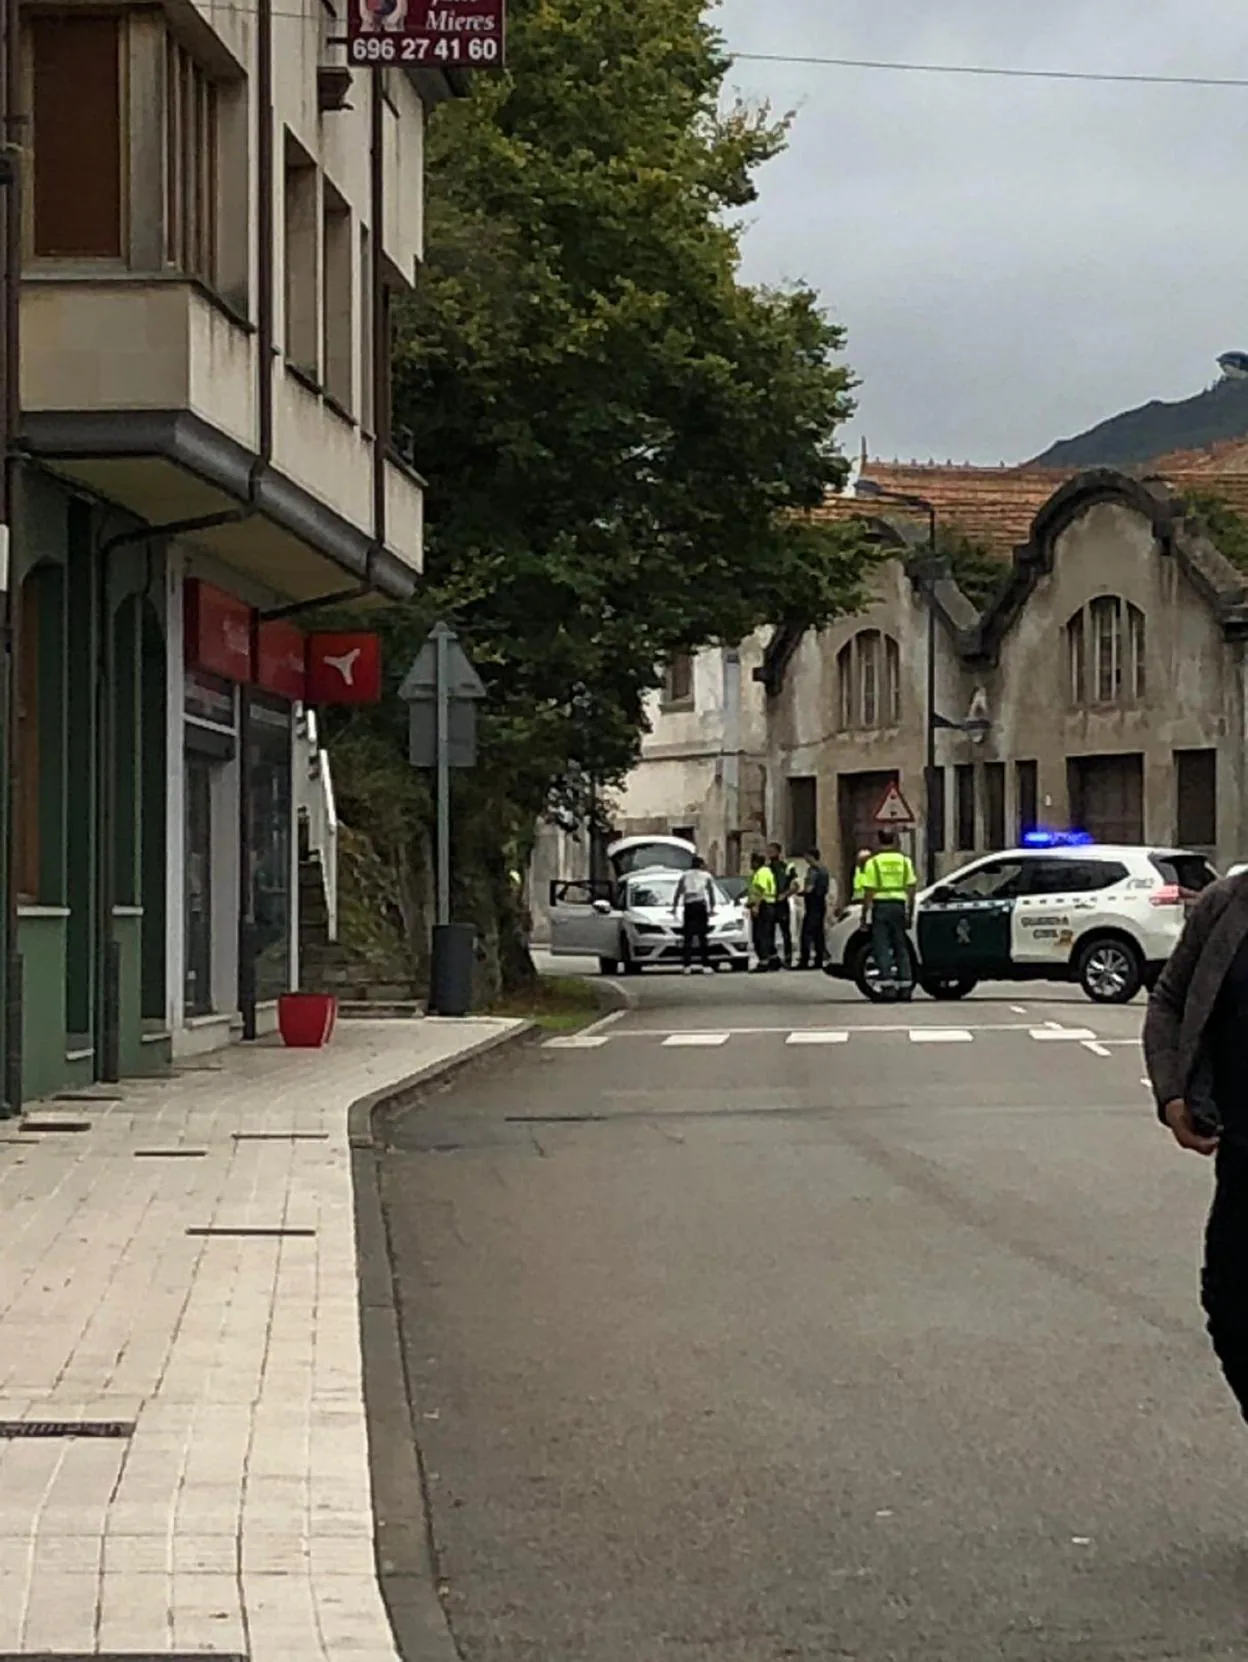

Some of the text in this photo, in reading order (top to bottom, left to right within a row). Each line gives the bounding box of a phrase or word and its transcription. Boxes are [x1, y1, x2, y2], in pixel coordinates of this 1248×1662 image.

[425, 10, 495, 32] Mieres
[352, 37, 497, 60] 696 27 41 60
